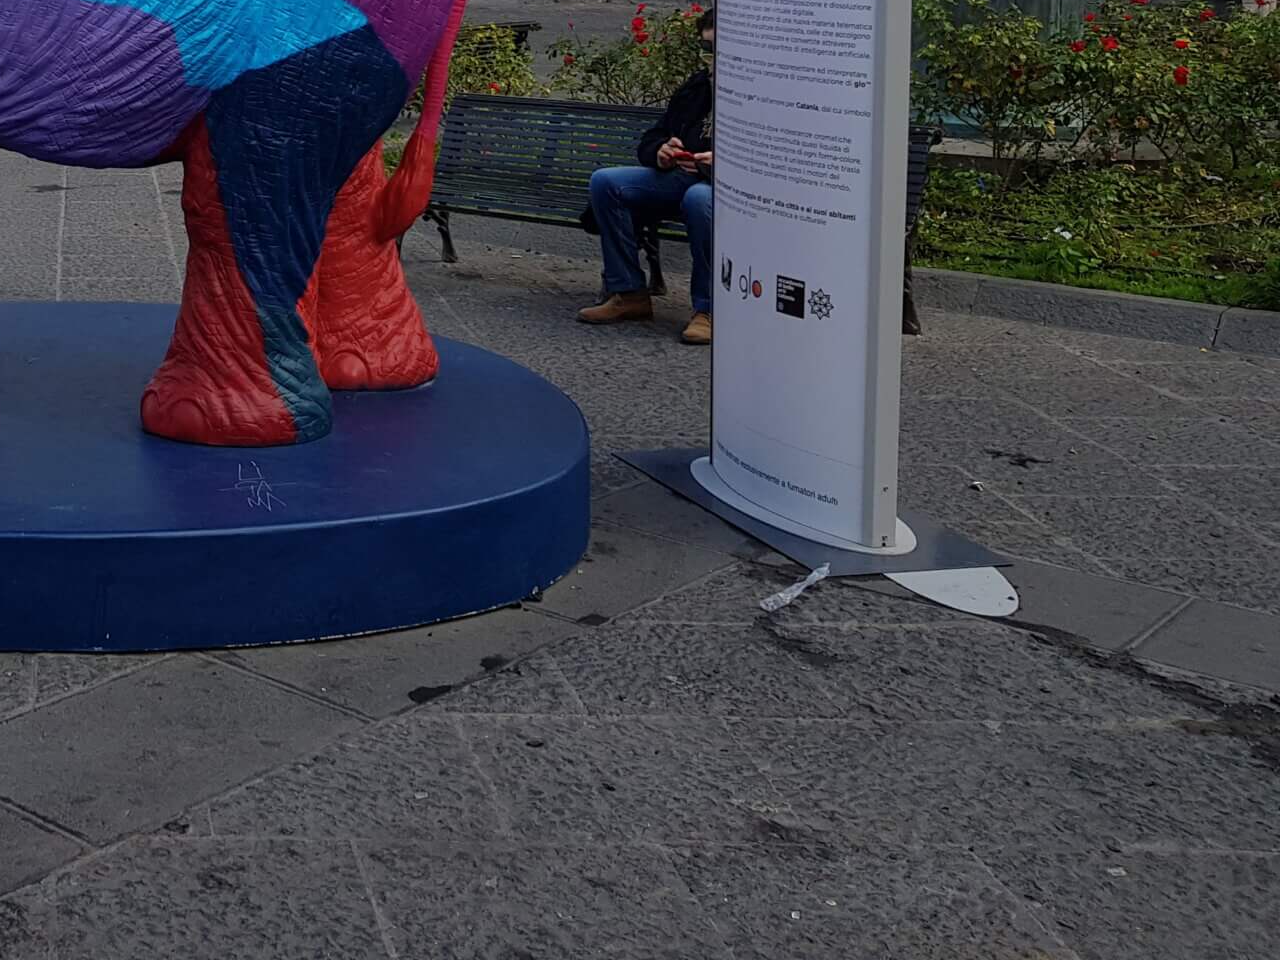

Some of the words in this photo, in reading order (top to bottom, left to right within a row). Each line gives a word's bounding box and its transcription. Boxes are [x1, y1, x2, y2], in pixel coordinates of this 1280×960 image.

[828, 210, 857, 222] abitanti
[738, 265, 763, 301] glo
[787, 480, 816, 498] fumatori
[817, 493, 839, 506] adulti
